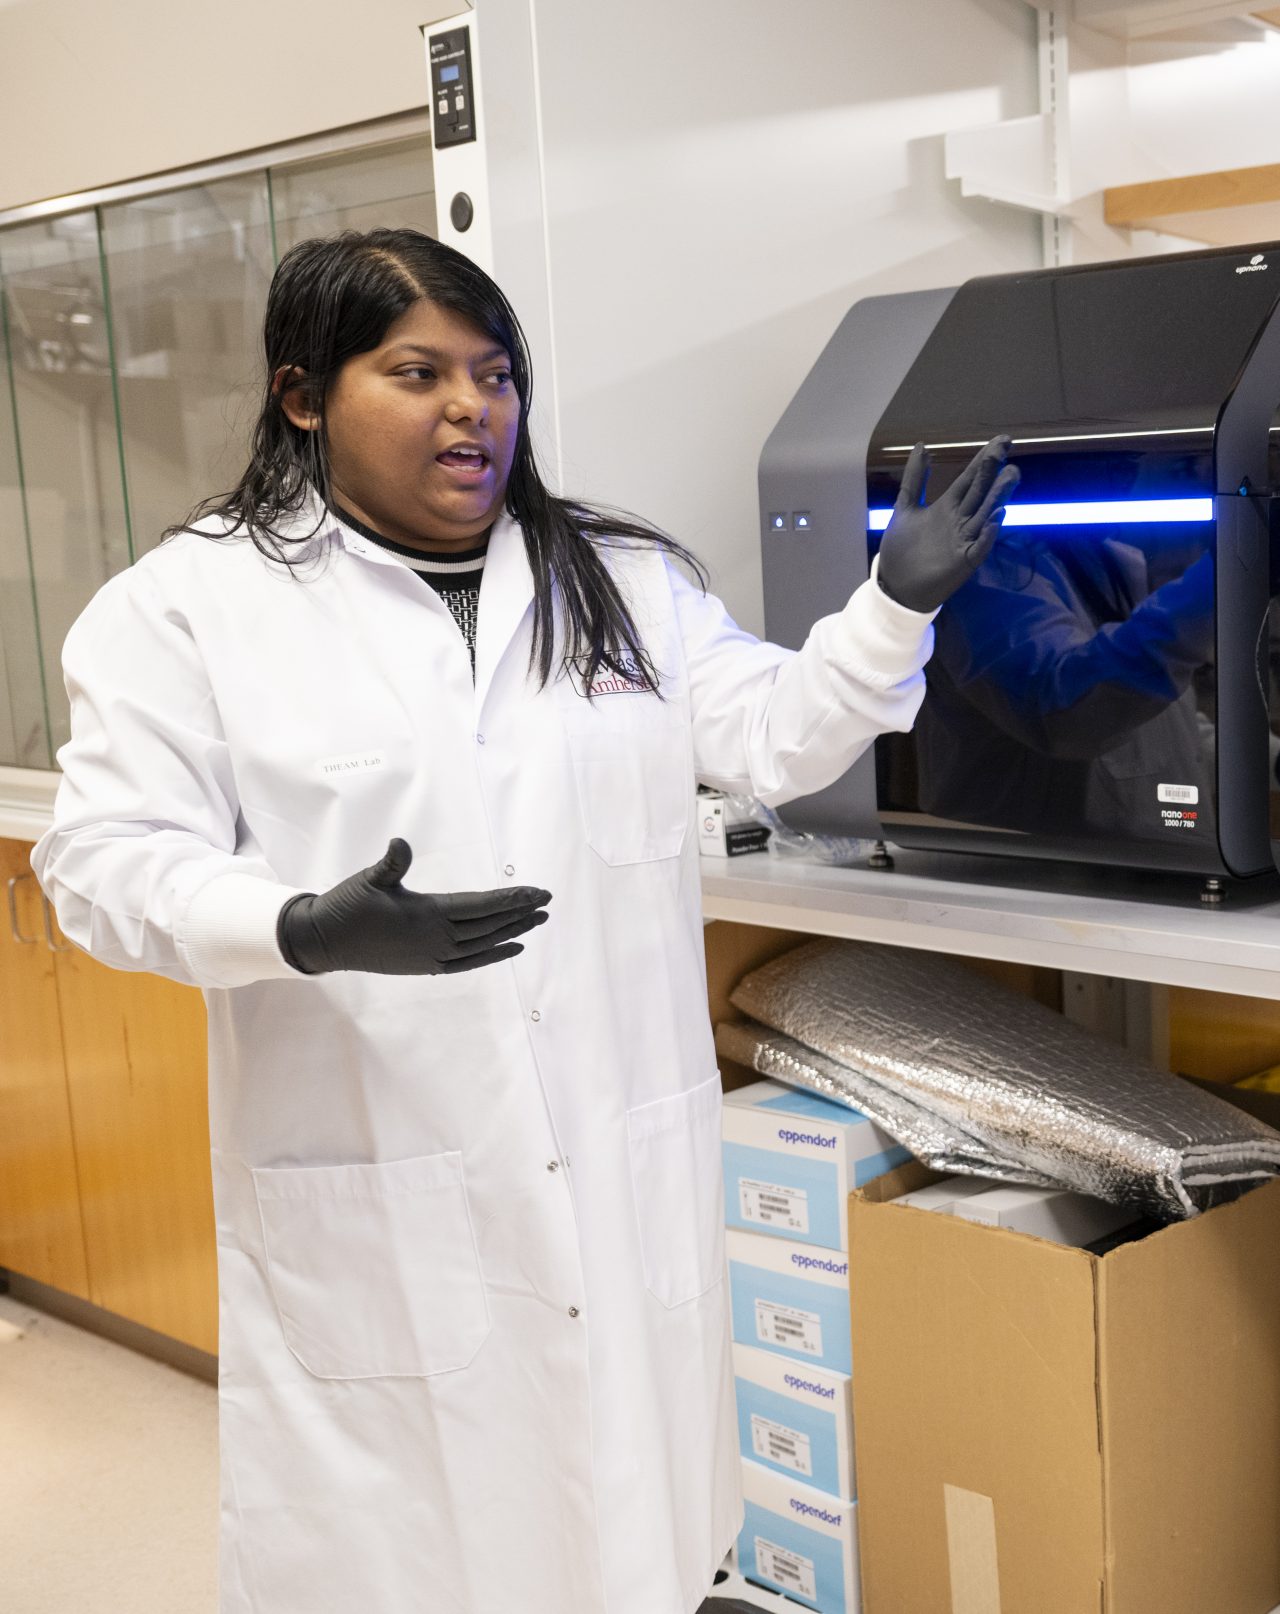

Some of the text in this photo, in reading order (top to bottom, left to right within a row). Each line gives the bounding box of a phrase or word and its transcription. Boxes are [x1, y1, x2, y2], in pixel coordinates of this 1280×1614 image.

[1236, 264, 1268, 274] upnano
[1182, 820, 1194, 828] 780
[778, 1129, 837, 1148] eppendorf
[792, 1254, 848, 1275] eppendorf
[784, 1374, 835, 1400] eppendorf
[790, 1498, 842, 1526] eppendorf
